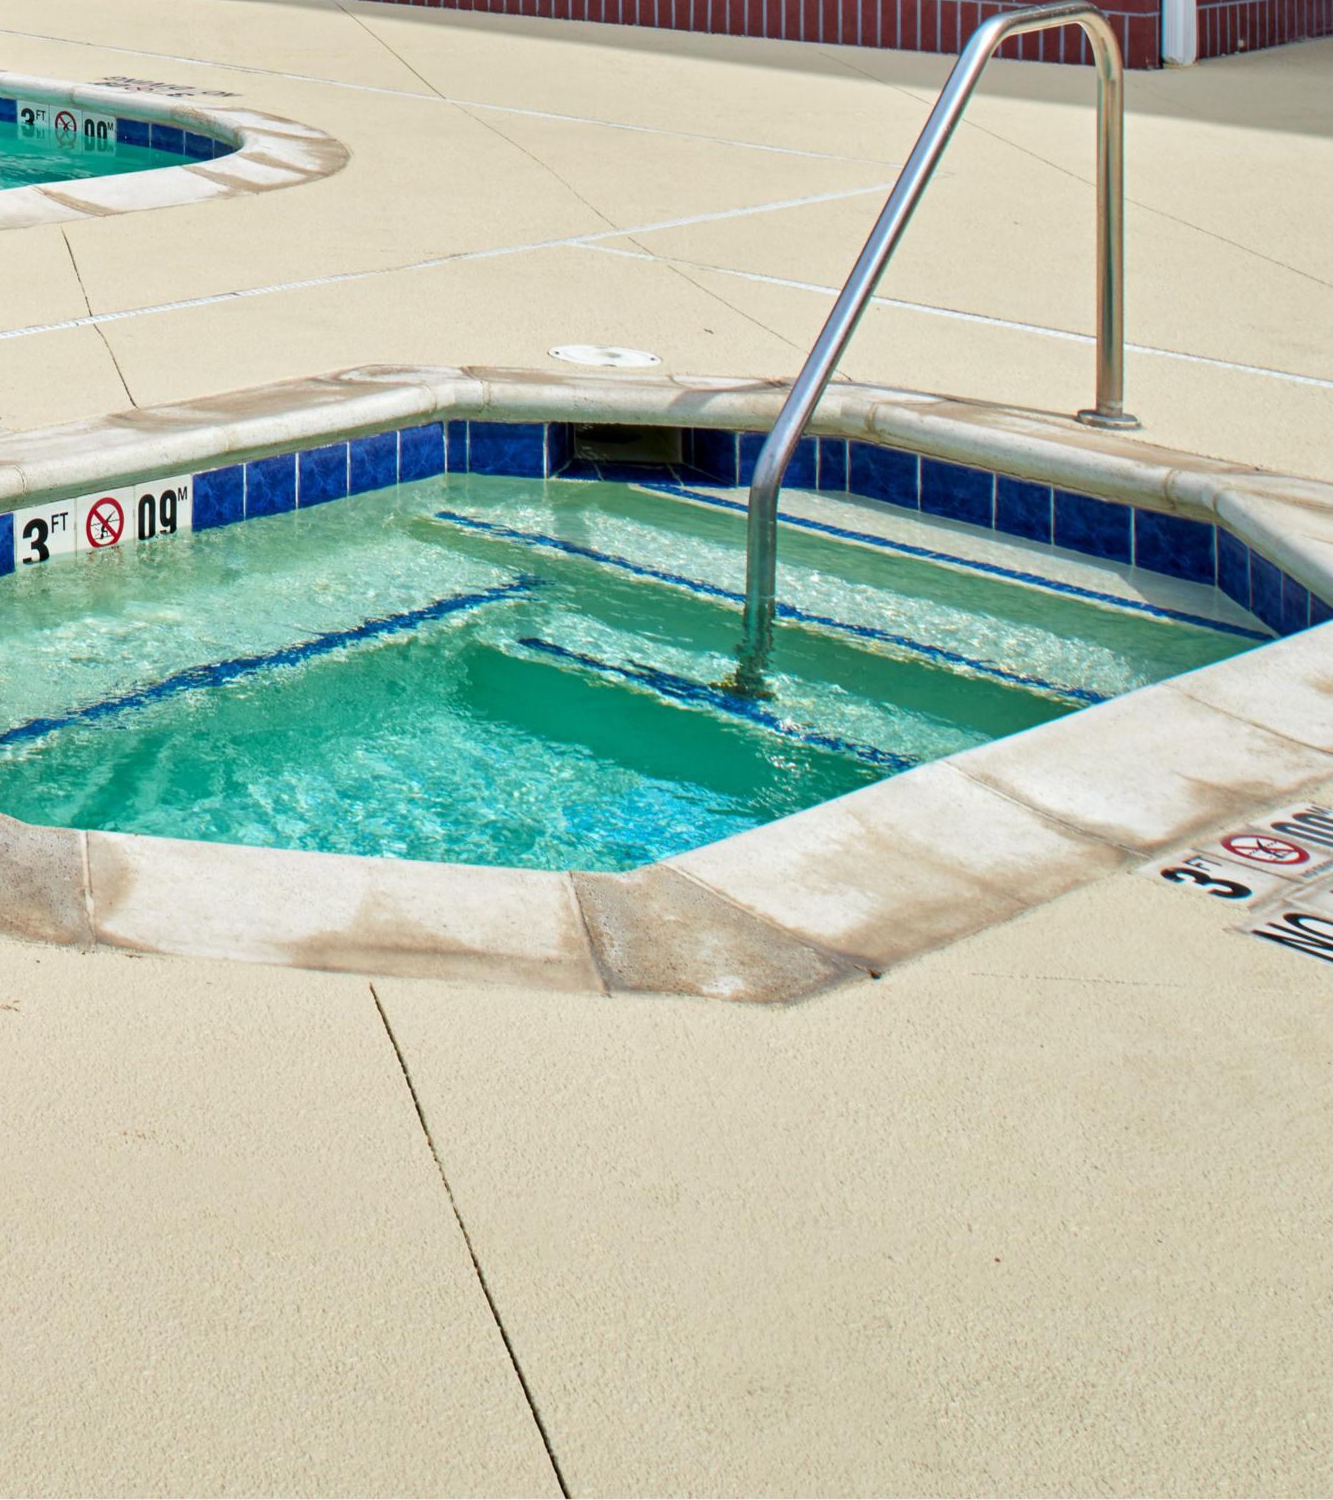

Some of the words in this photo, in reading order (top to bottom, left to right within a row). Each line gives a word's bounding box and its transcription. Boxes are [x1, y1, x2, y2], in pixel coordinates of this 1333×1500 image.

[36, 109, 46, 121] FT
[22, 518, 50, 565] 3
[51, 512, 68, 534] FT
[177, 486, 188, 501] M
[1182, 855, 1223, 872] FT
[1160, 866, 1253, 900] 3
